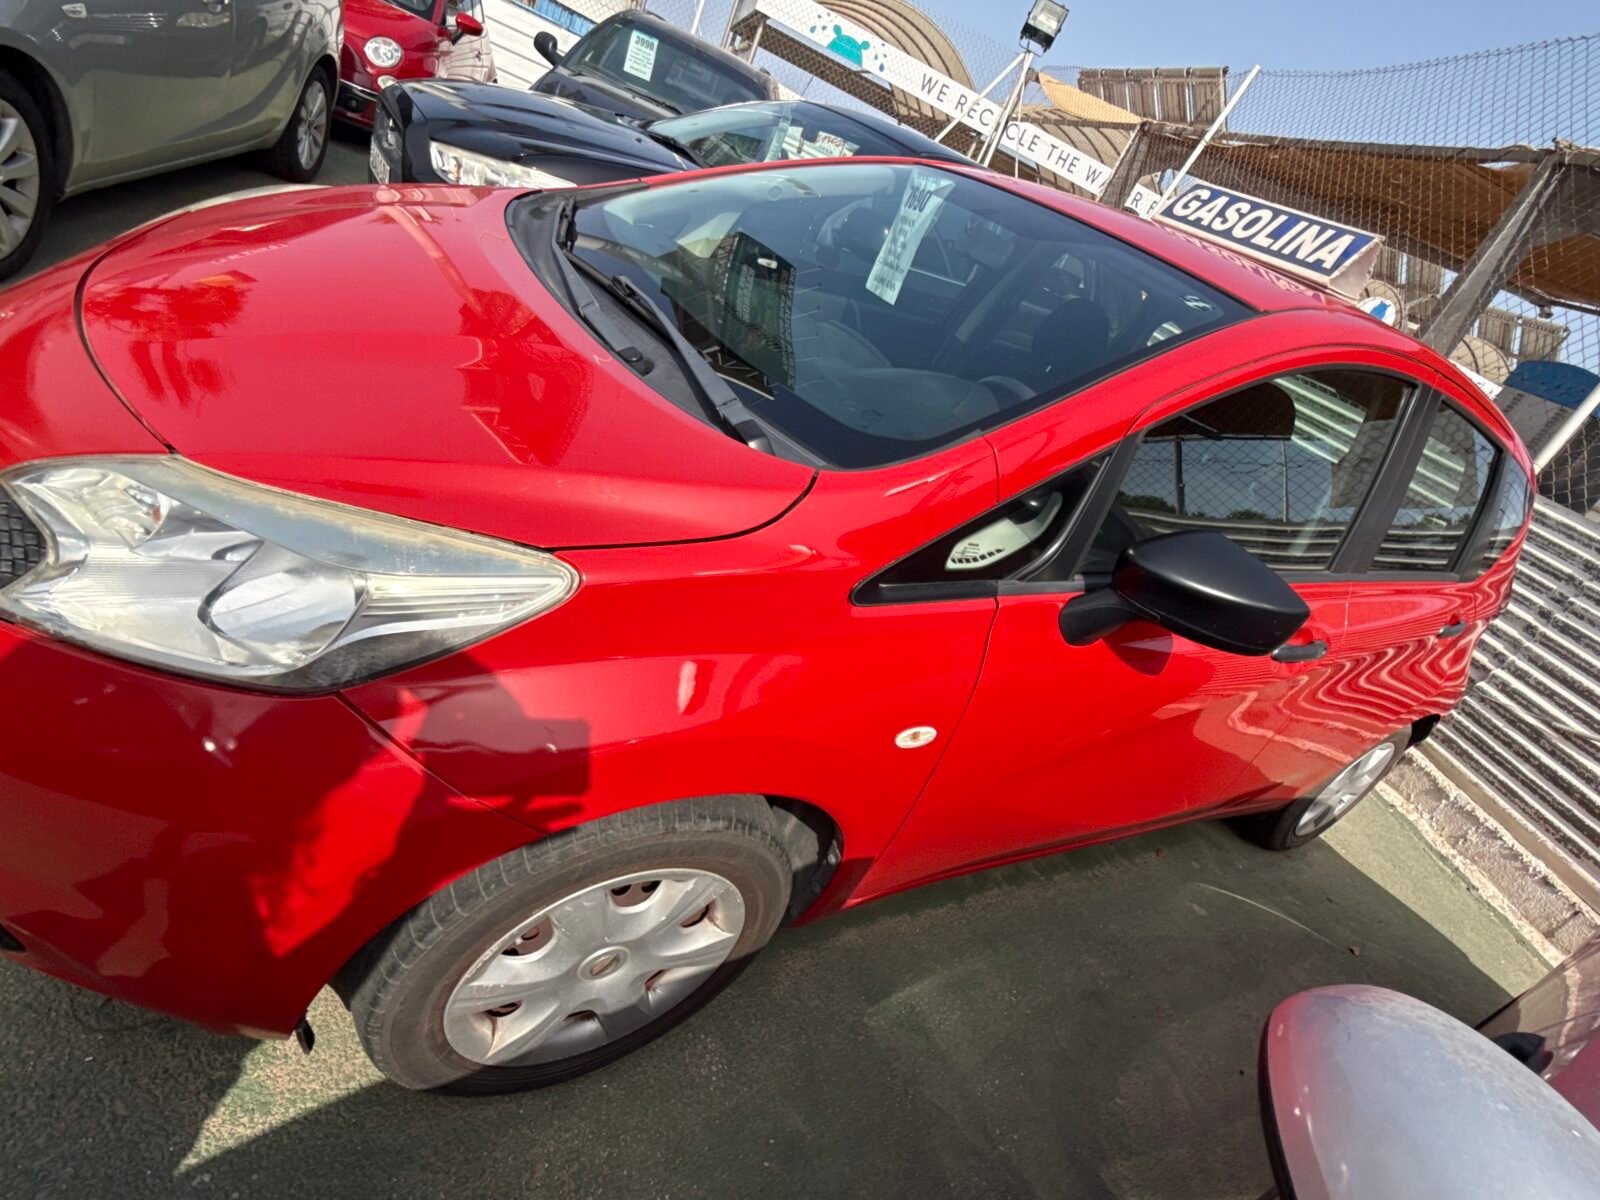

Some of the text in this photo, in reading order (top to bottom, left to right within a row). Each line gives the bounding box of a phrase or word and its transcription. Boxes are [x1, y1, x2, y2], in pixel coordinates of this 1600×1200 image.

[921, 73, 949, 102] WE
[955, 94, 1040, 152] RECCLE
[1047, 143, 1080, 173] THE
[1172, 188, 1355, 269] GASOLINA
